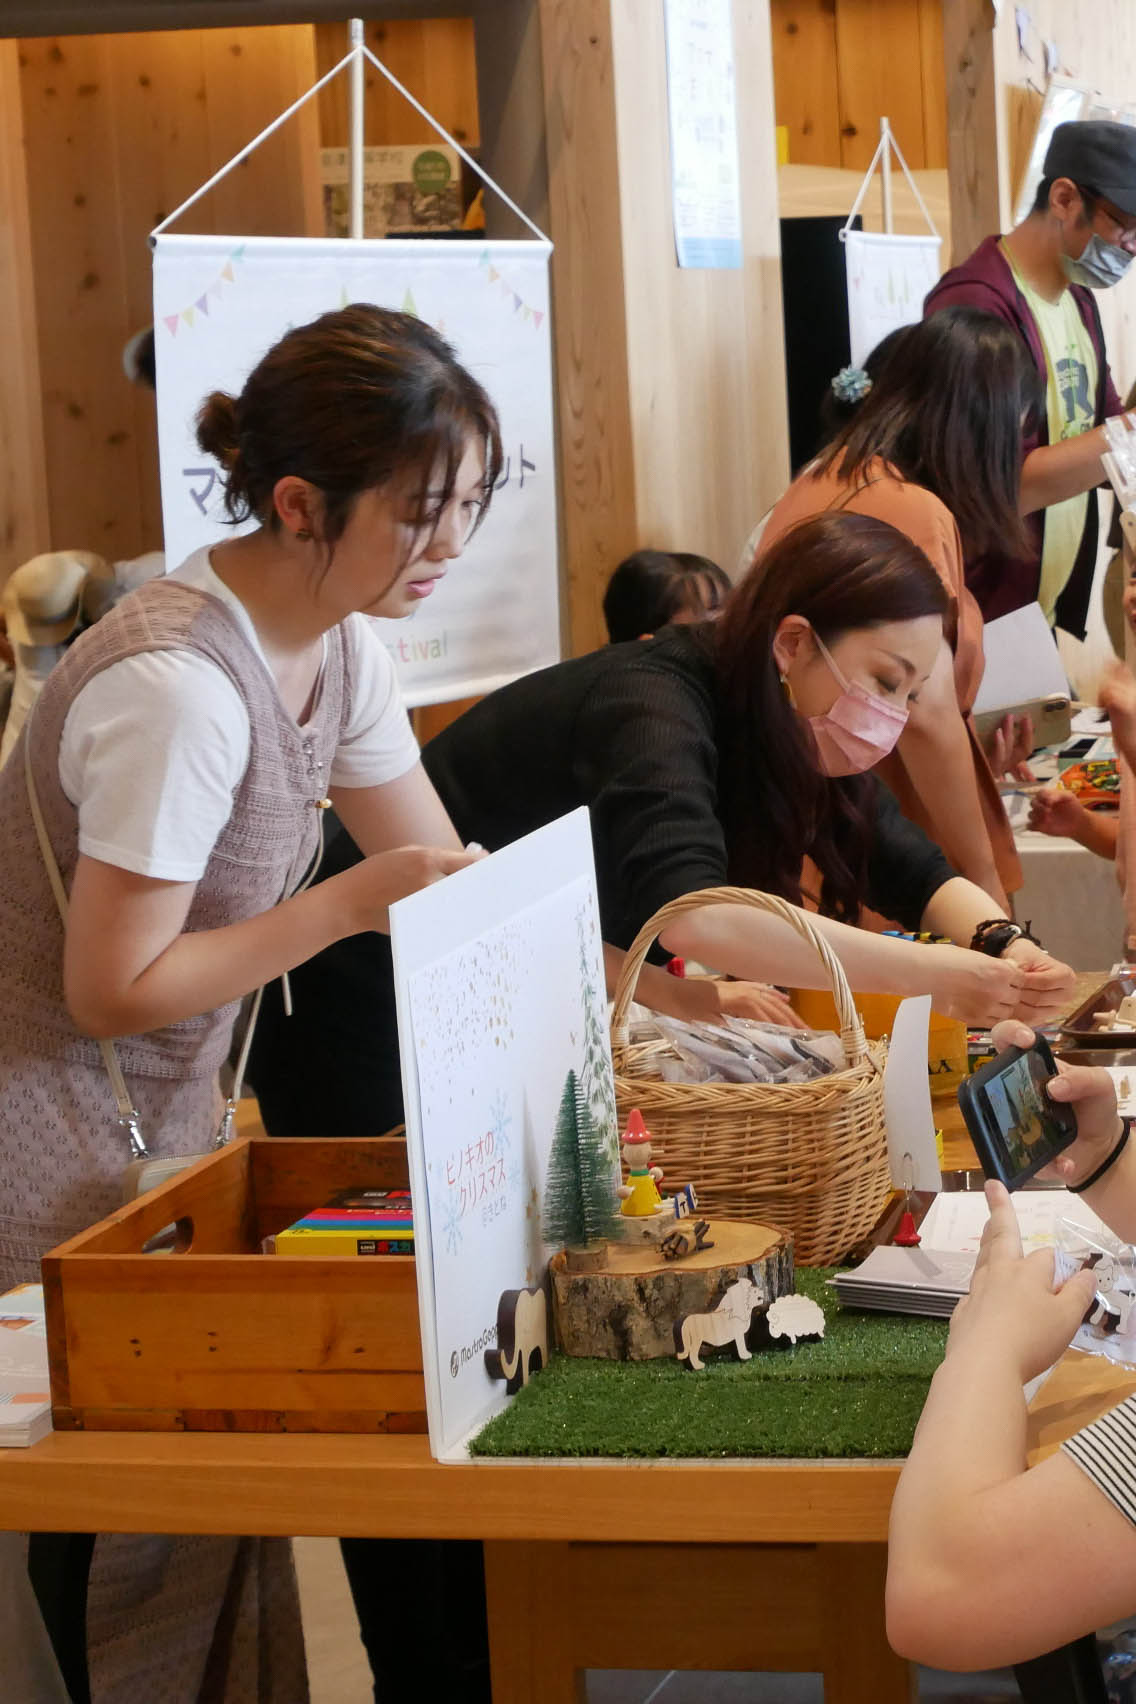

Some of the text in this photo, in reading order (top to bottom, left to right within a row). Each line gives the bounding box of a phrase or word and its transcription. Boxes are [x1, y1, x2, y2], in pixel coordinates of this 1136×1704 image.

[386, 630, 448, 663] tival
[446, 1131, 494, 1185] ピノキオの
[460, 1157, 506, 1217] クリスマス
